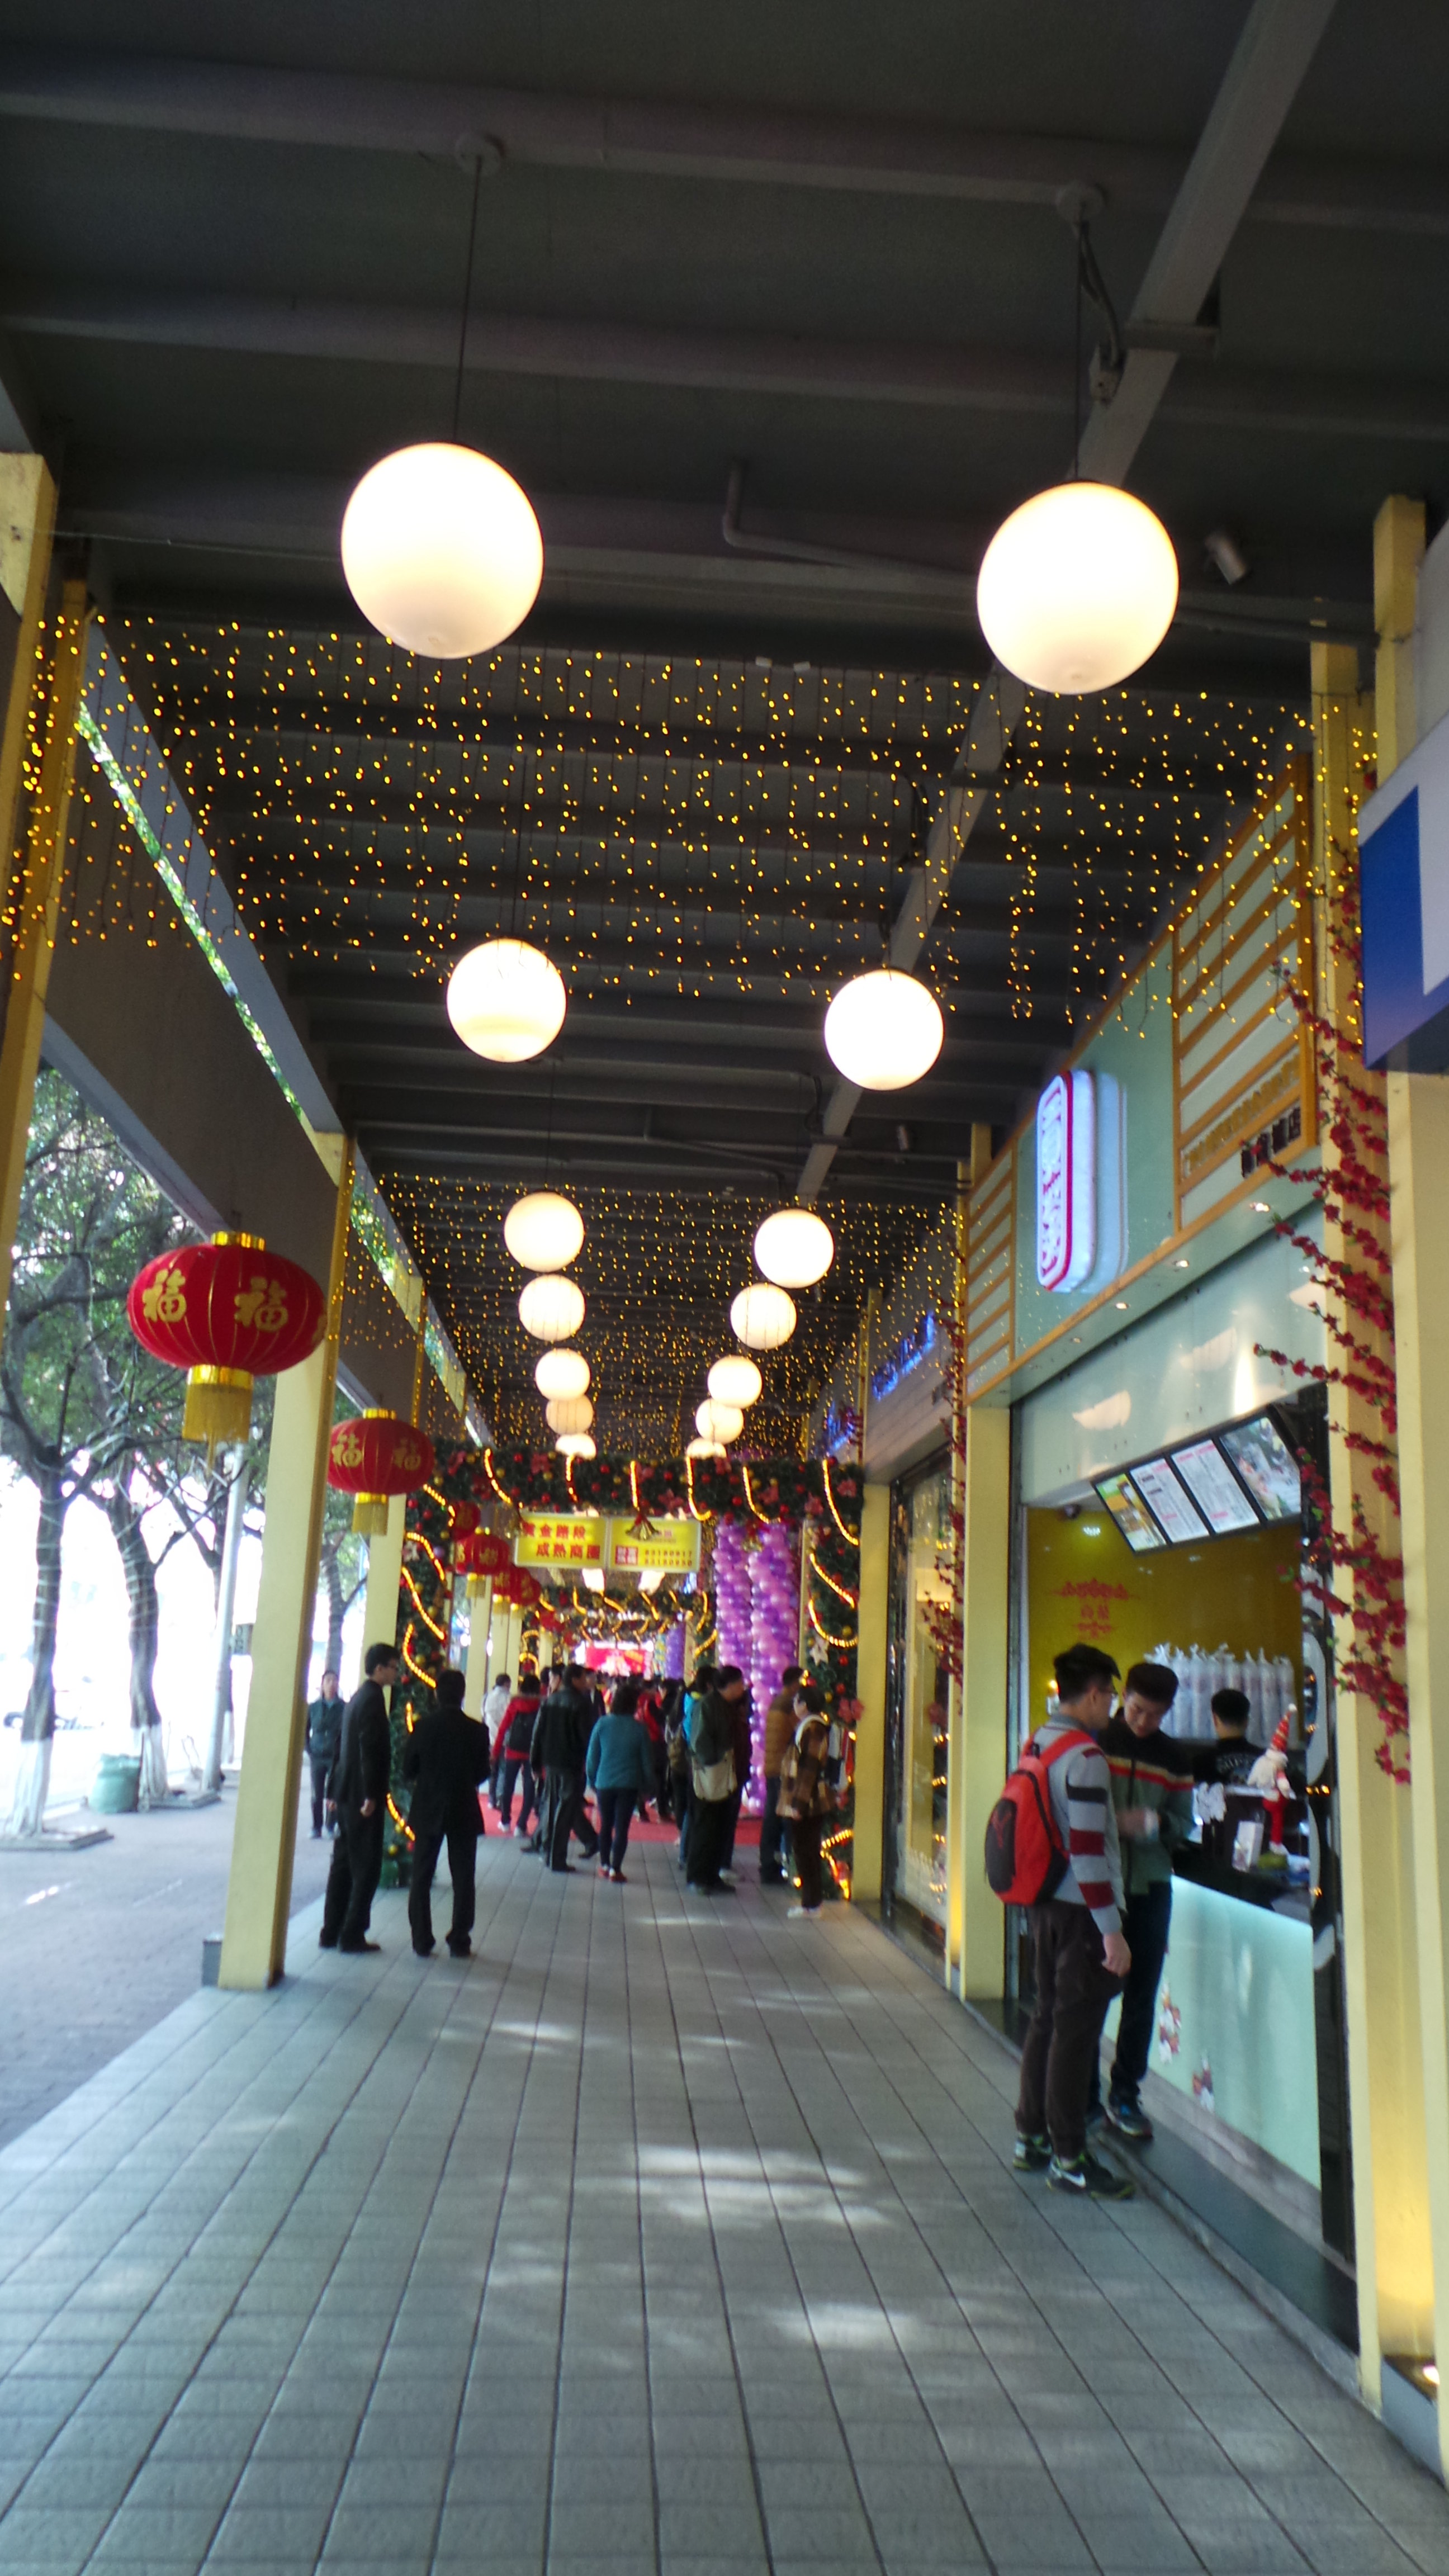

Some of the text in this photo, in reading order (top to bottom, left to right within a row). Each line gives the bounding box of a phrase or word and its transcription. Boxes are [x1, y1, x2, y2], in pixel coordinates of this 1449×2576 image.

[142, 1268, 187, 1323] 福
[234, 1276, 288, 1332] 福
[332, 1433, 363, 1468] 福
